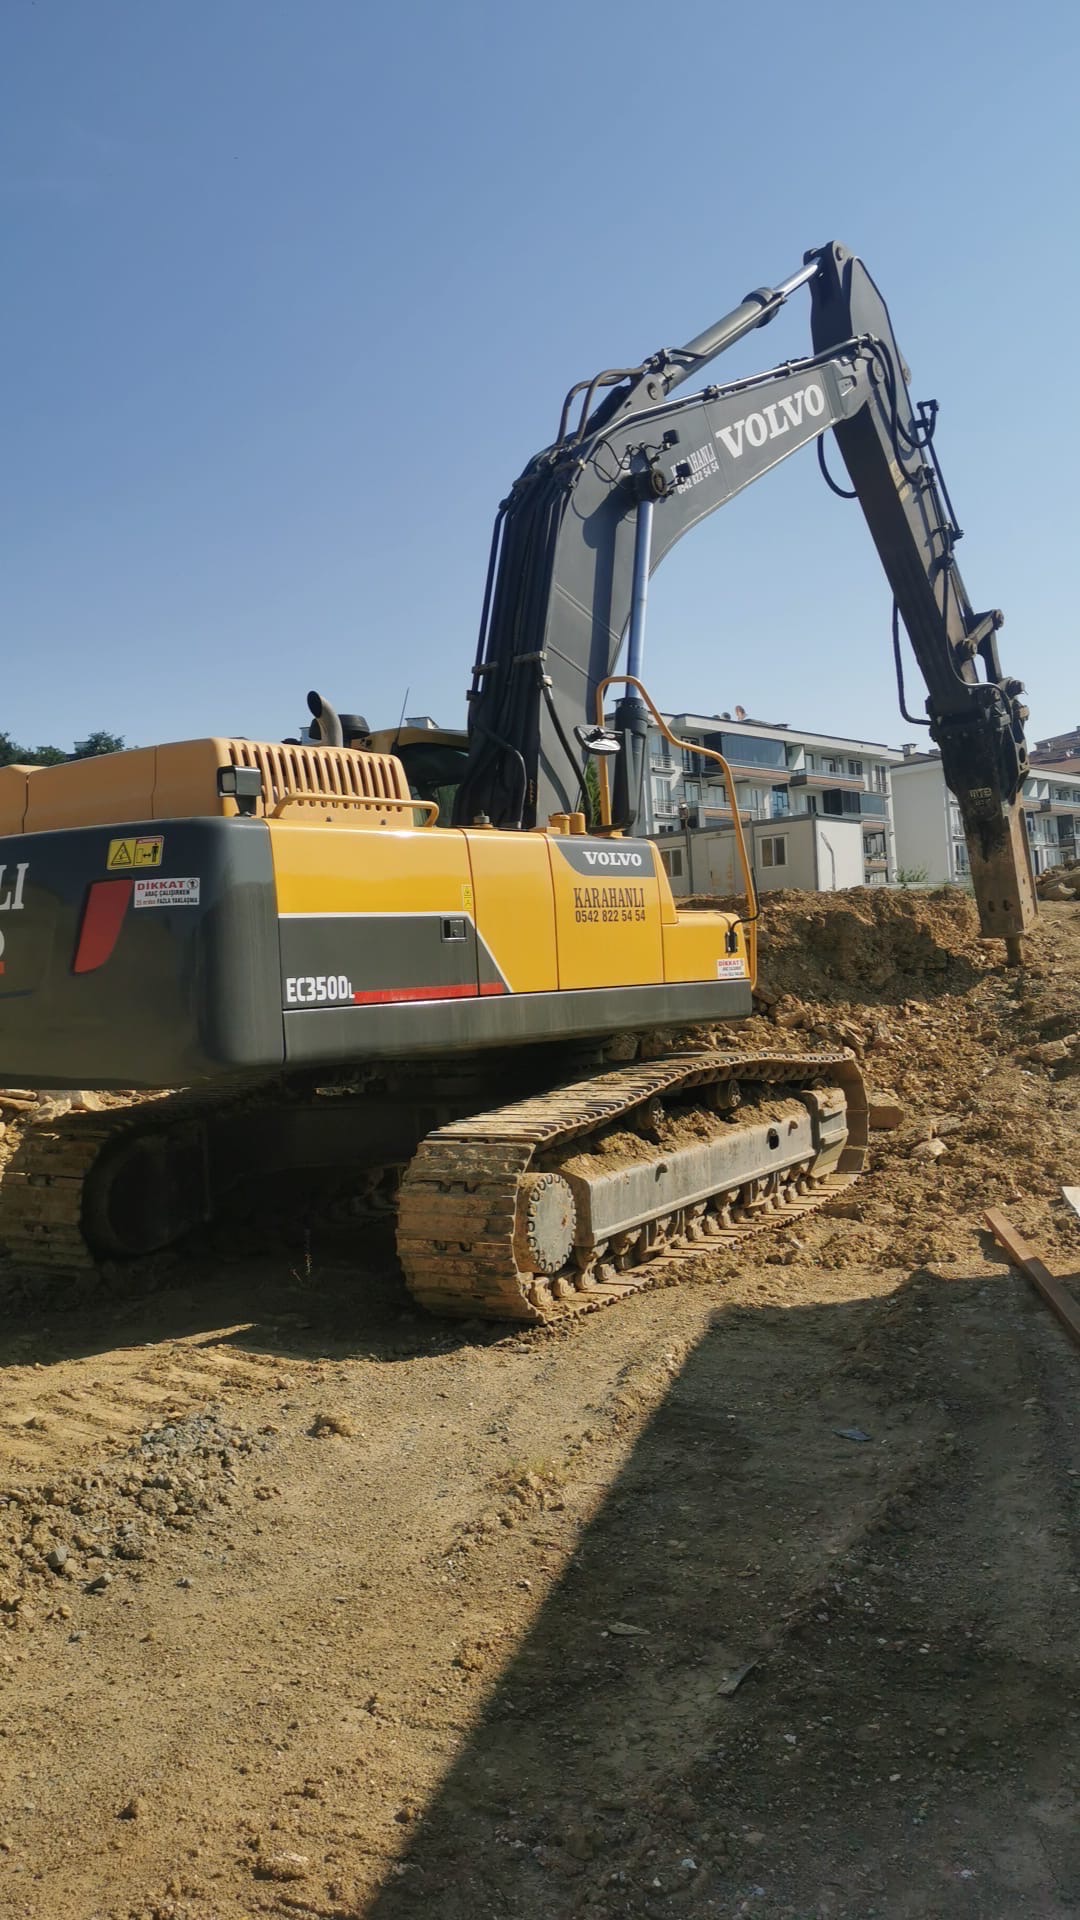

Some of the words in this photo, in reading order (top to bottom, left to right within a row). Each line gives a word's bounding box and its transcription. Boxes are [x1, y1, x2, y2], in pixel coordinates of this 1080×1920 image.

[715, 384, 825, 458] VOLVO
[703, 465, 712, 477] 54
[711, 460, 720, 472] 54
[582, 851, 642, 867] VOLVO
[137, 880, 186, 891] DİKKAT
[573, 887, 645, 909] KARAHANLI
[575, 910, 599, 923] 0542
[602, 909, 619, 922] 822
[621, 909, 633, 922] 54
[635, 909, 646, 922] 54
